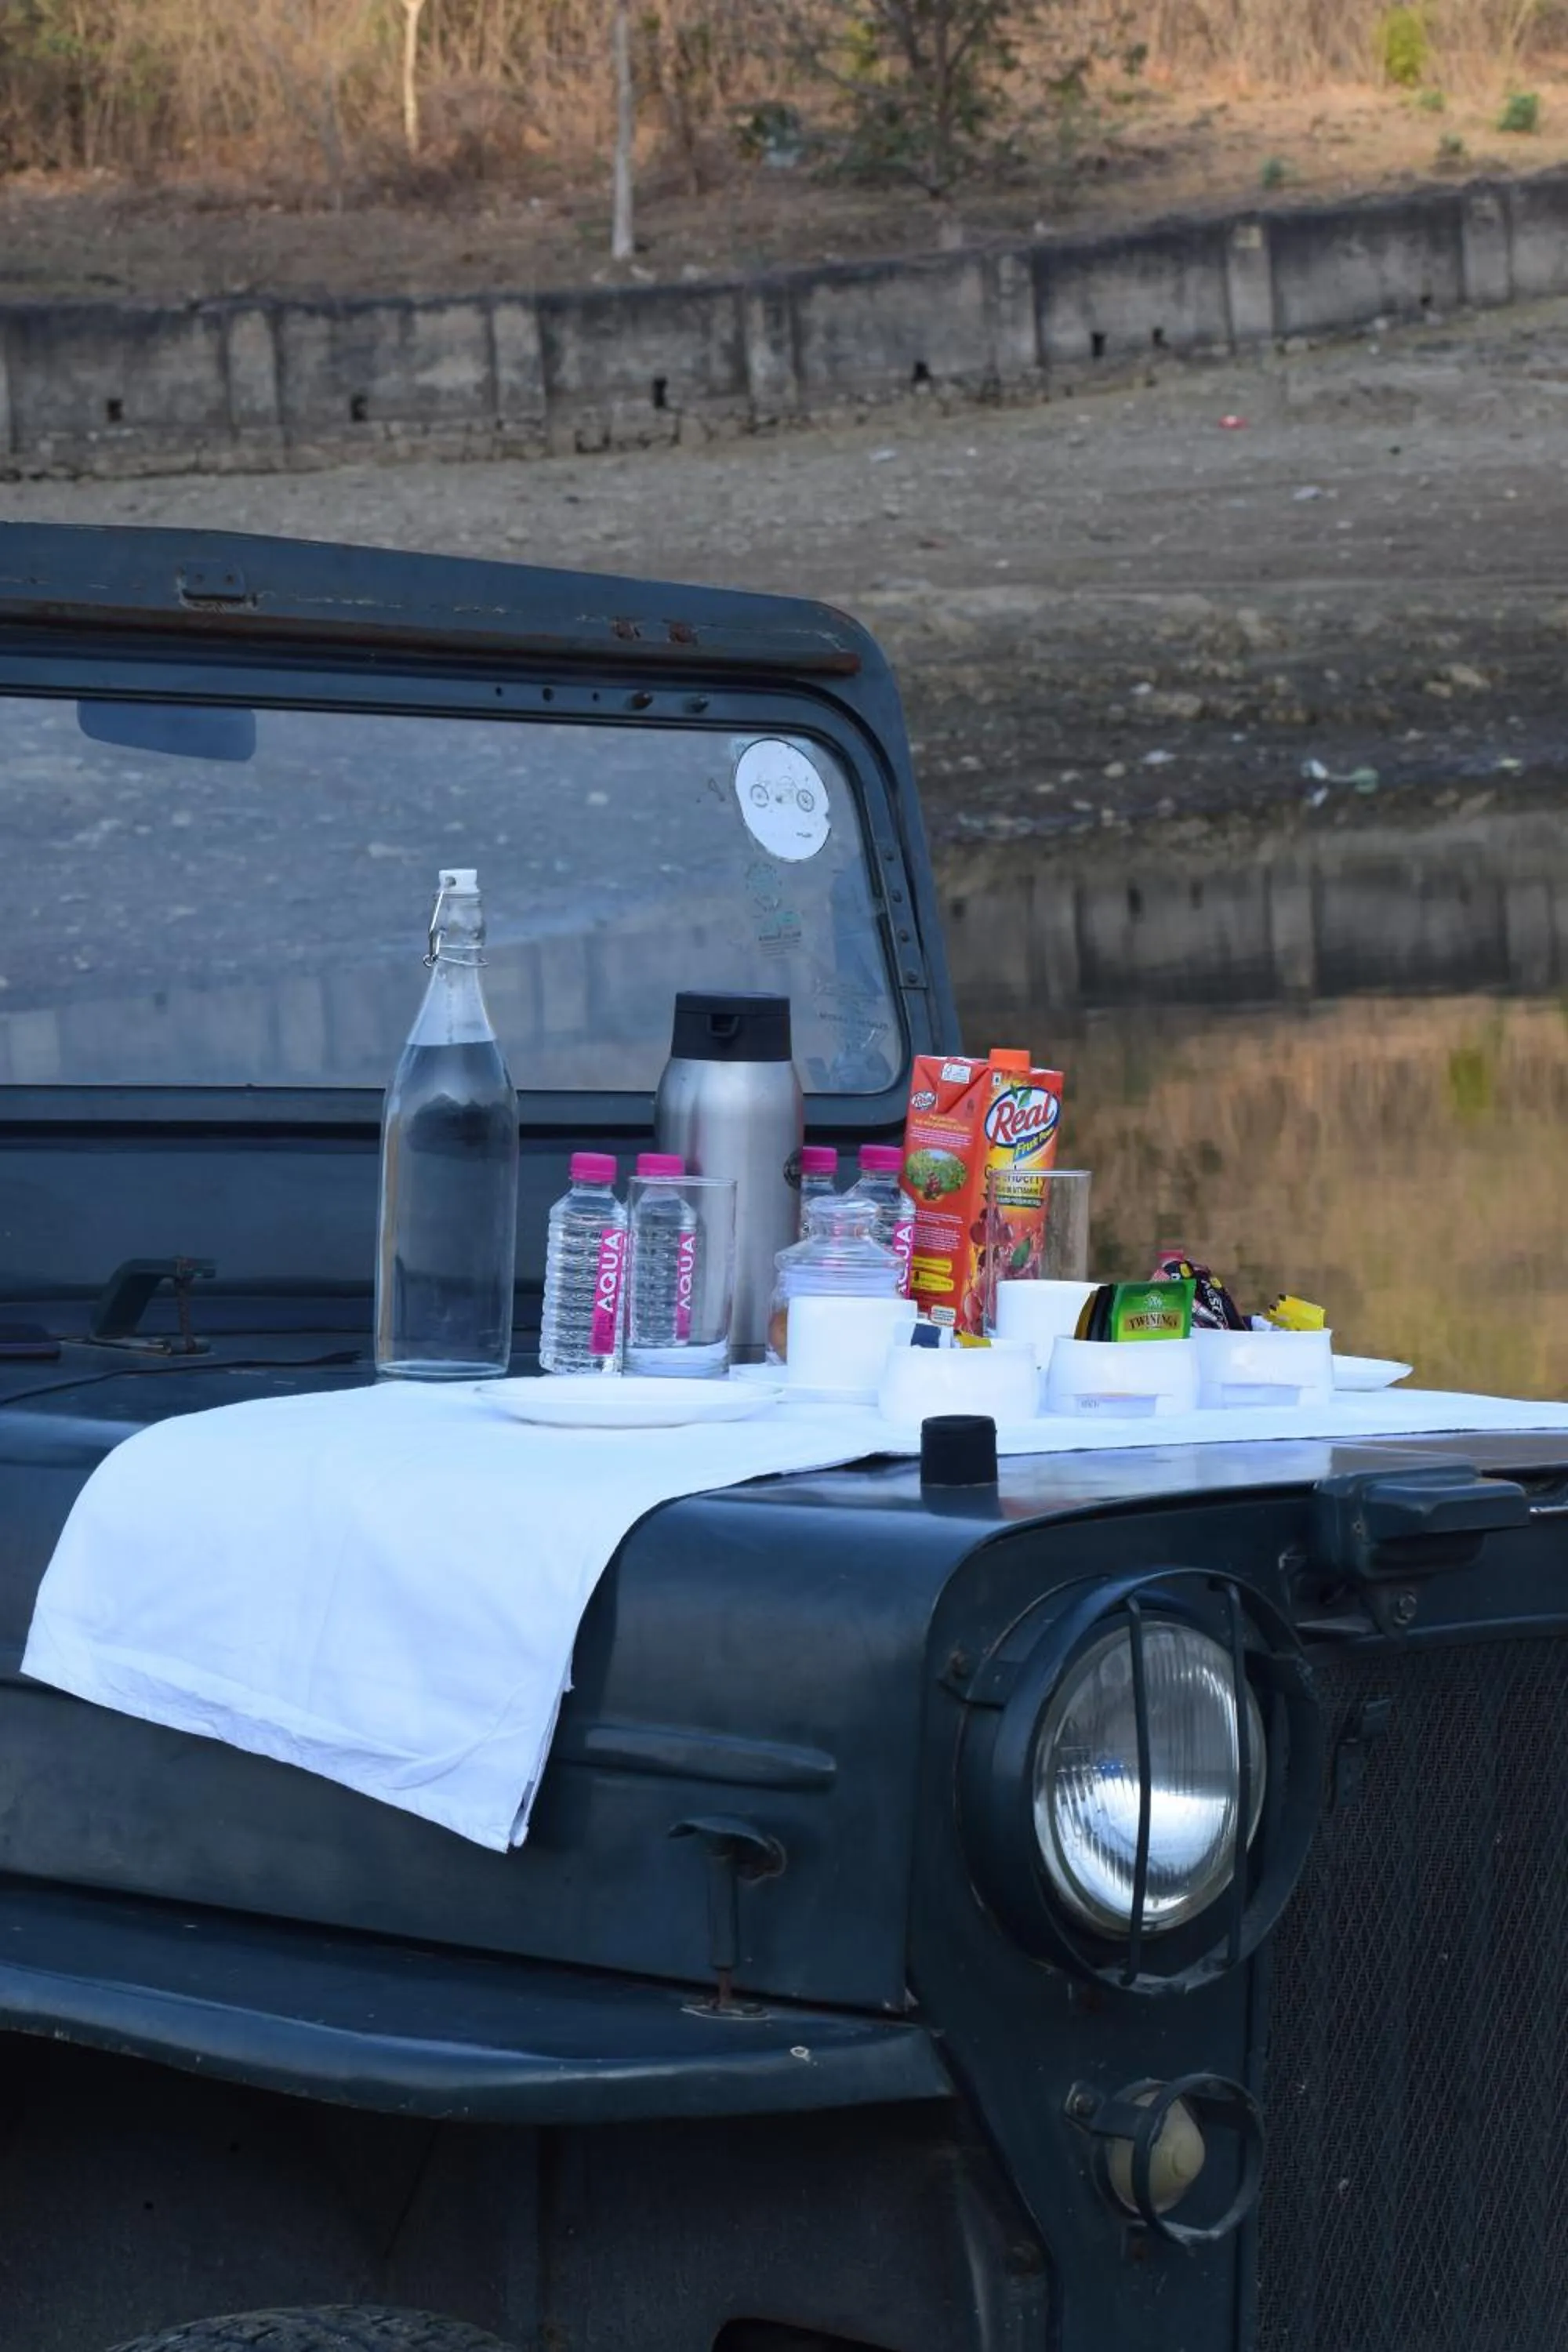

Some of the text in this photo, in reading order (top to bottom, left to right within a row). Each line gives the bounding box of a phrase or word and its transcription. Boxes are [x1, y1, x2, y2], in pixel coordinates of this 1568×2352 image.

[990, 1093, 1054, 1150] Real
[597, 1232, 622, 1313] AQUA
[679, 1236, 695, 1310] AQUA
